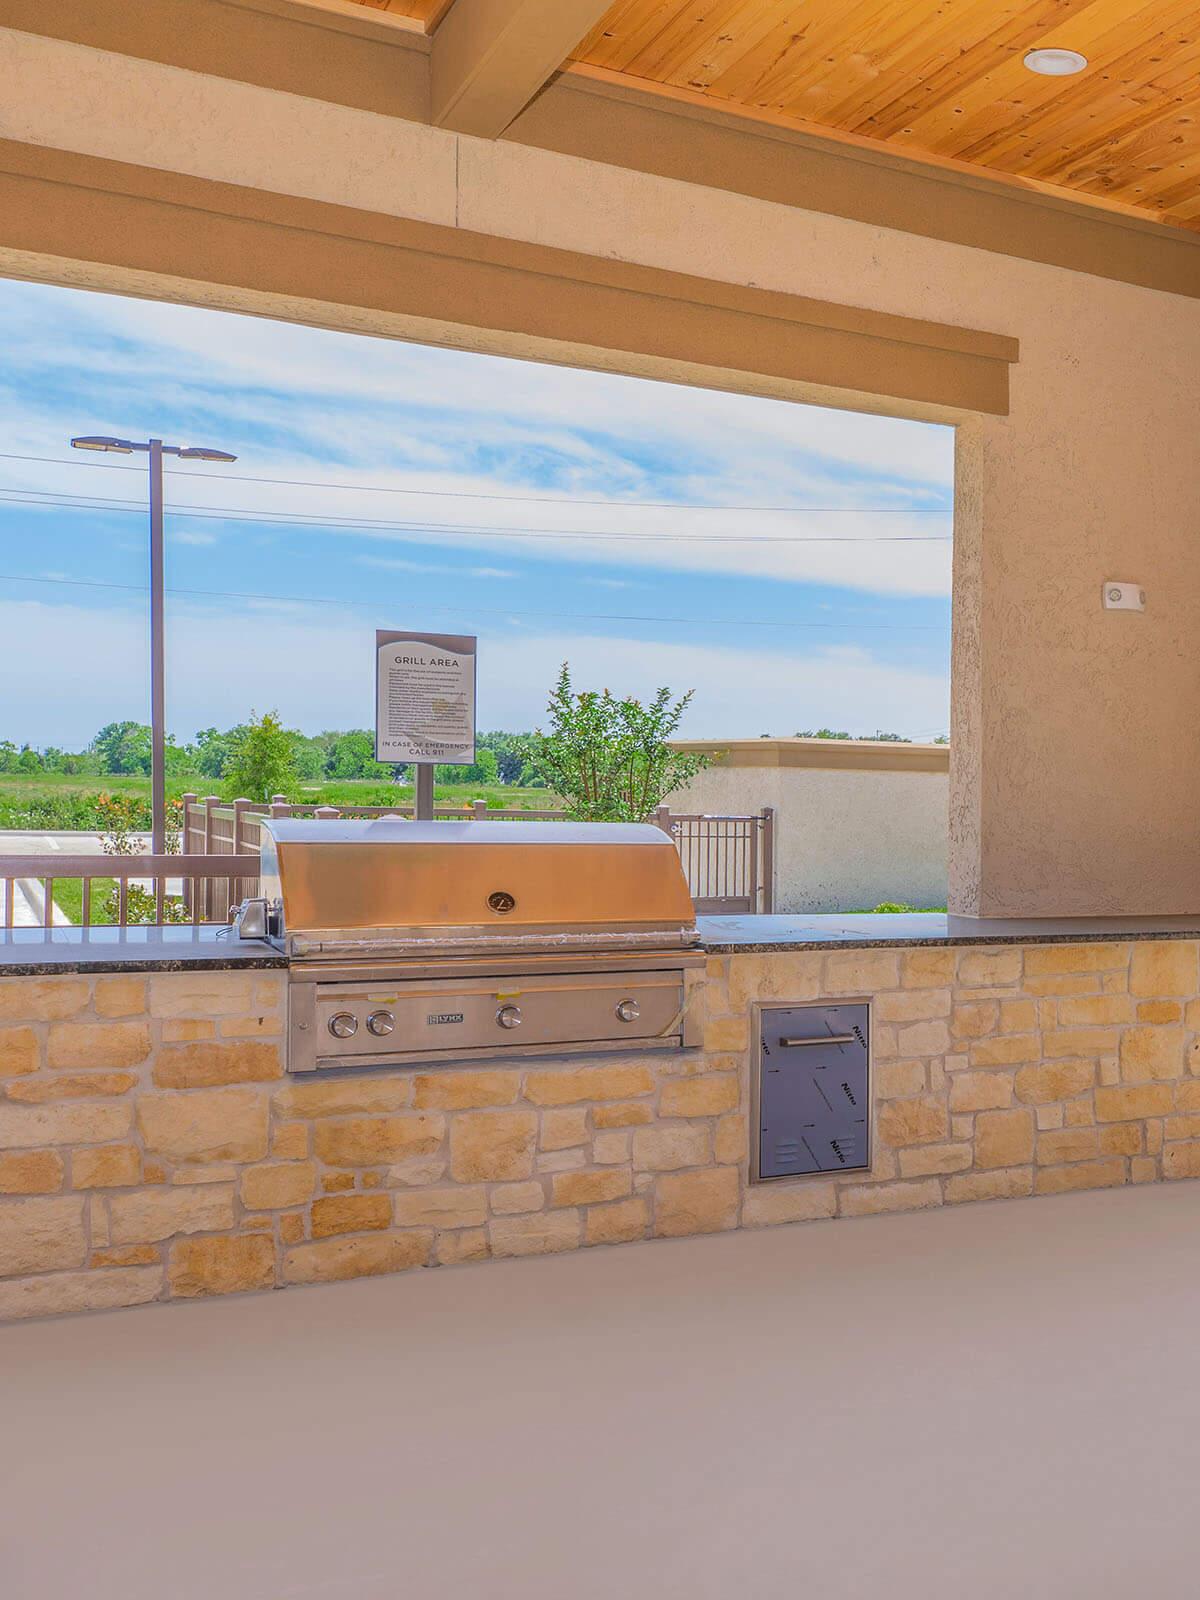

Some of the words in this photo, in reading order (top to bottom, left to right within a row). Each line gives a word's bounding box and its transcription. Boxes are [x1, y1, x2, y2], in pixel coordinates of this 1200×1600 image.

[394, 656, 426, 666] GRILL
[429, 658, 459, 667] AREA
[409, 748, 430, 756] CALL
[425, 742, 469, 750] EMERGENCY
[761, 1035, 771, 1055] itto
[852, 1025, 867, 1049] Nitto
[841, 1082, 857, 1106] Nitto
[830, 1140, 846, 1164] Nitto
